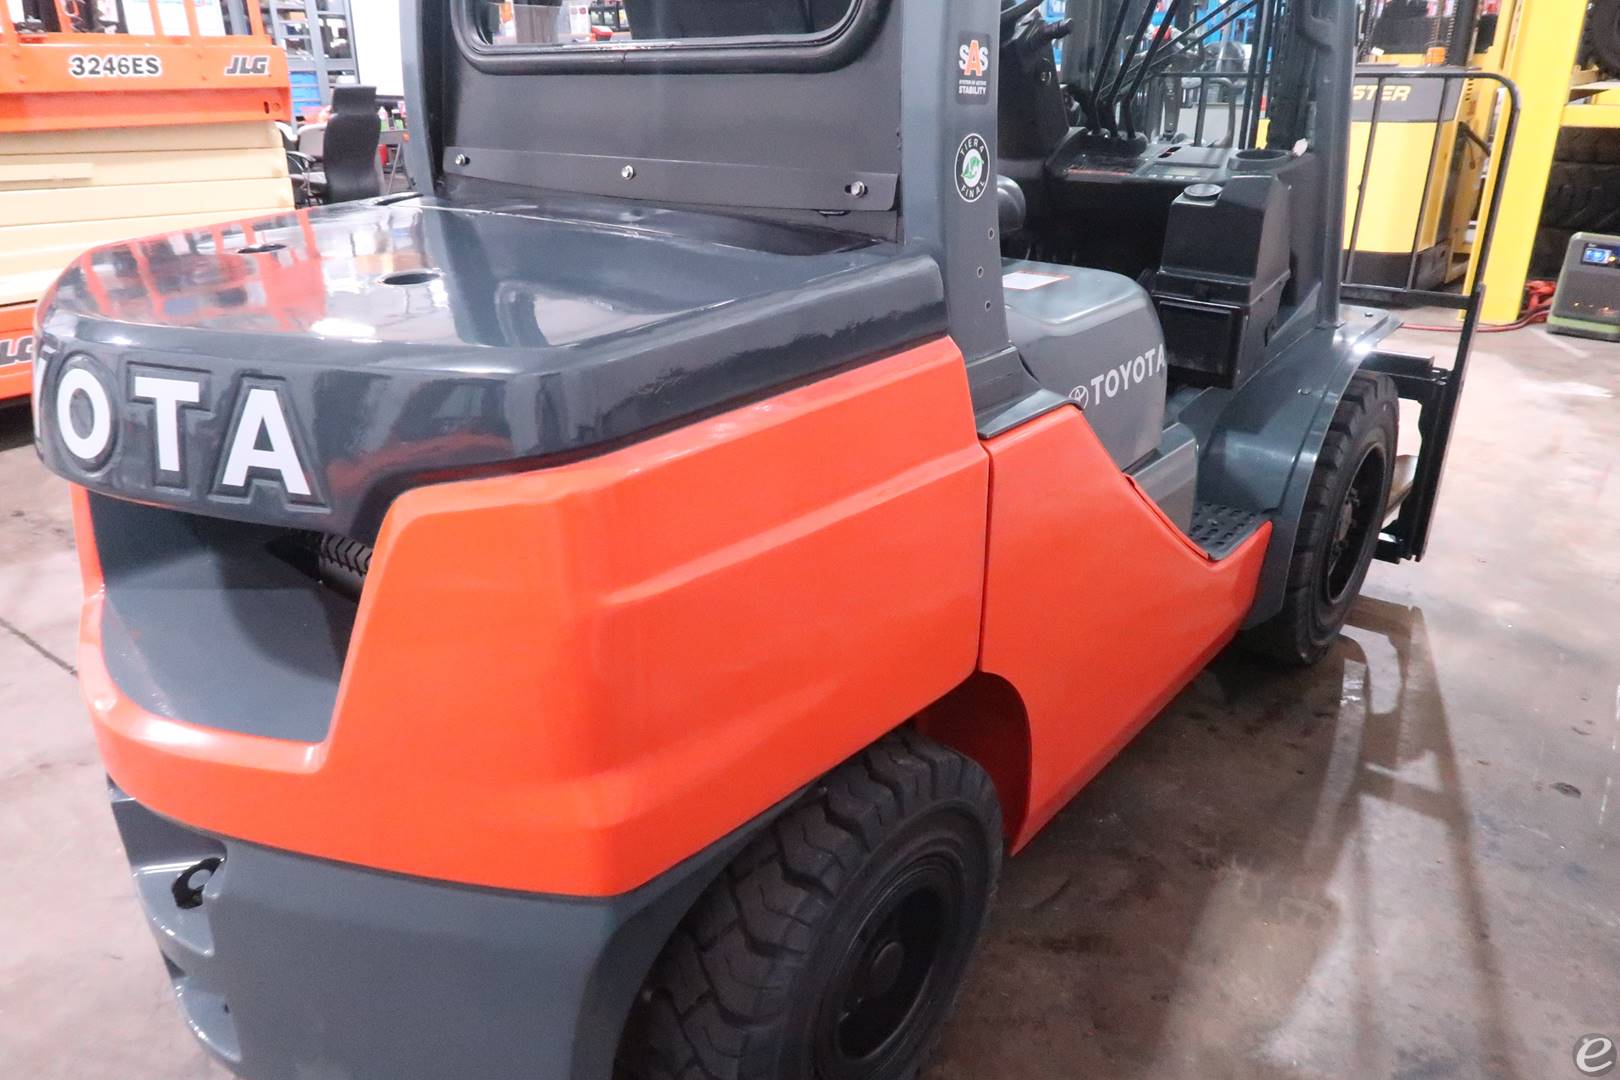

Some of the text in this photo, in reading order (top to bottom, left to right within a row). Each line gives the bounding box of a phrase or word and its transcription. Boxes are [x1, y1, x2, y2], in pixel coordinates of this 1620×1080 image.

[71, 56, 160, 76] 3246ES
[226, 57, 268, 74] JLG
[959, 39, 989, 77] SAS
[958, 85, 987, 95] STABILITY
[1352, 84, 1412, 102] STER
[960, 138, 979, 156] TIER
[961, 181, 985, 198] FINAL
[1090, 343, 1165, 406] TOYOTA
[35, 358, 312, 496] OTA
